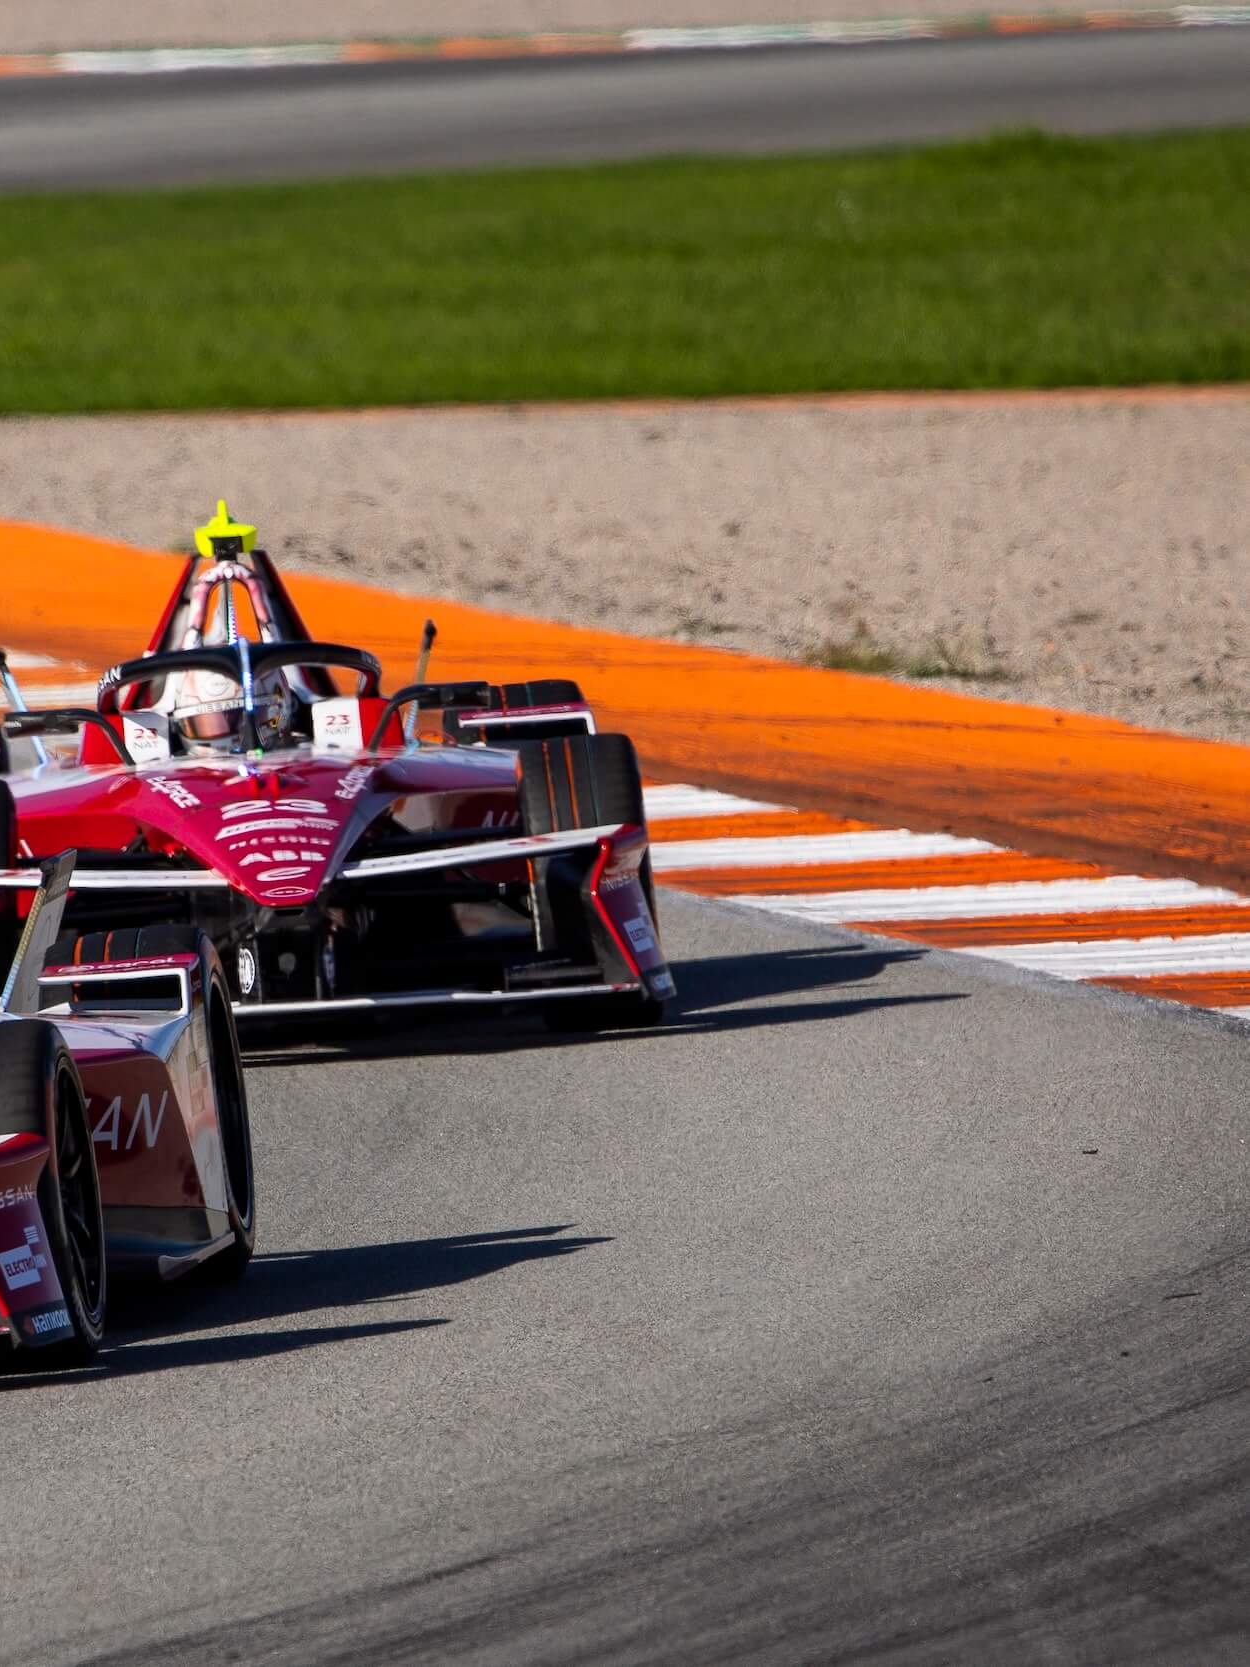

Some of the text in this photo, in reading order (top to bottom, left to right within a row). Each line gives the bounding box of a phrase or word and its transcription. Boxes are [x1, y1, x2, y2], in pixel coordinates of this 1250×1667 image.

[326, 714, 350, 725] 23
[134, 728, 157, 739] 23
[221, 799, 329, 820] 23
[239, 850, 327, 866] ABB
